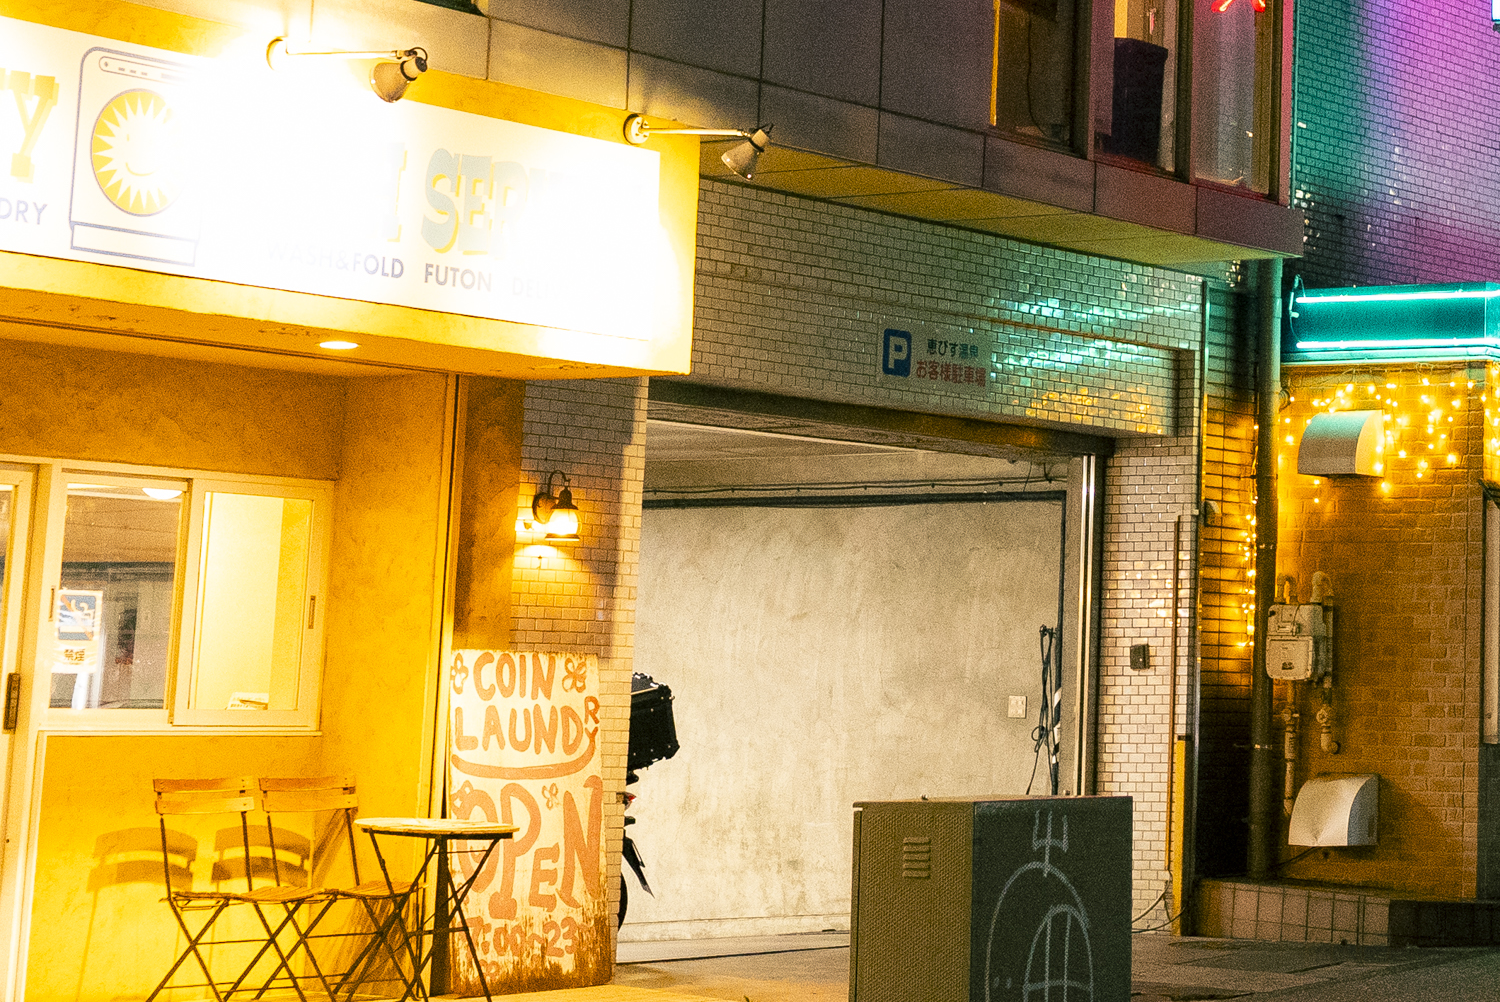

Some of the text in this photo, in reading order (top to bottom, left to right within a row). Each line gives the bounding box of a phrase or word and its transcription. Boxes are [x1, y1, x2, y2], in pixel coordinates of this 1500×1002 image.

[423, 262, 493, 293] FUTON
[887, 335, 908, 369] P
[926, 338, 979, 359] 恵びす温泉
[916, 359, 986, 387] お客様駐車場
[473, 651, 556, 701] COIN
[454, 695, 600, 756] LAUNDRY
[452, 774, 604, 920] OPEN
